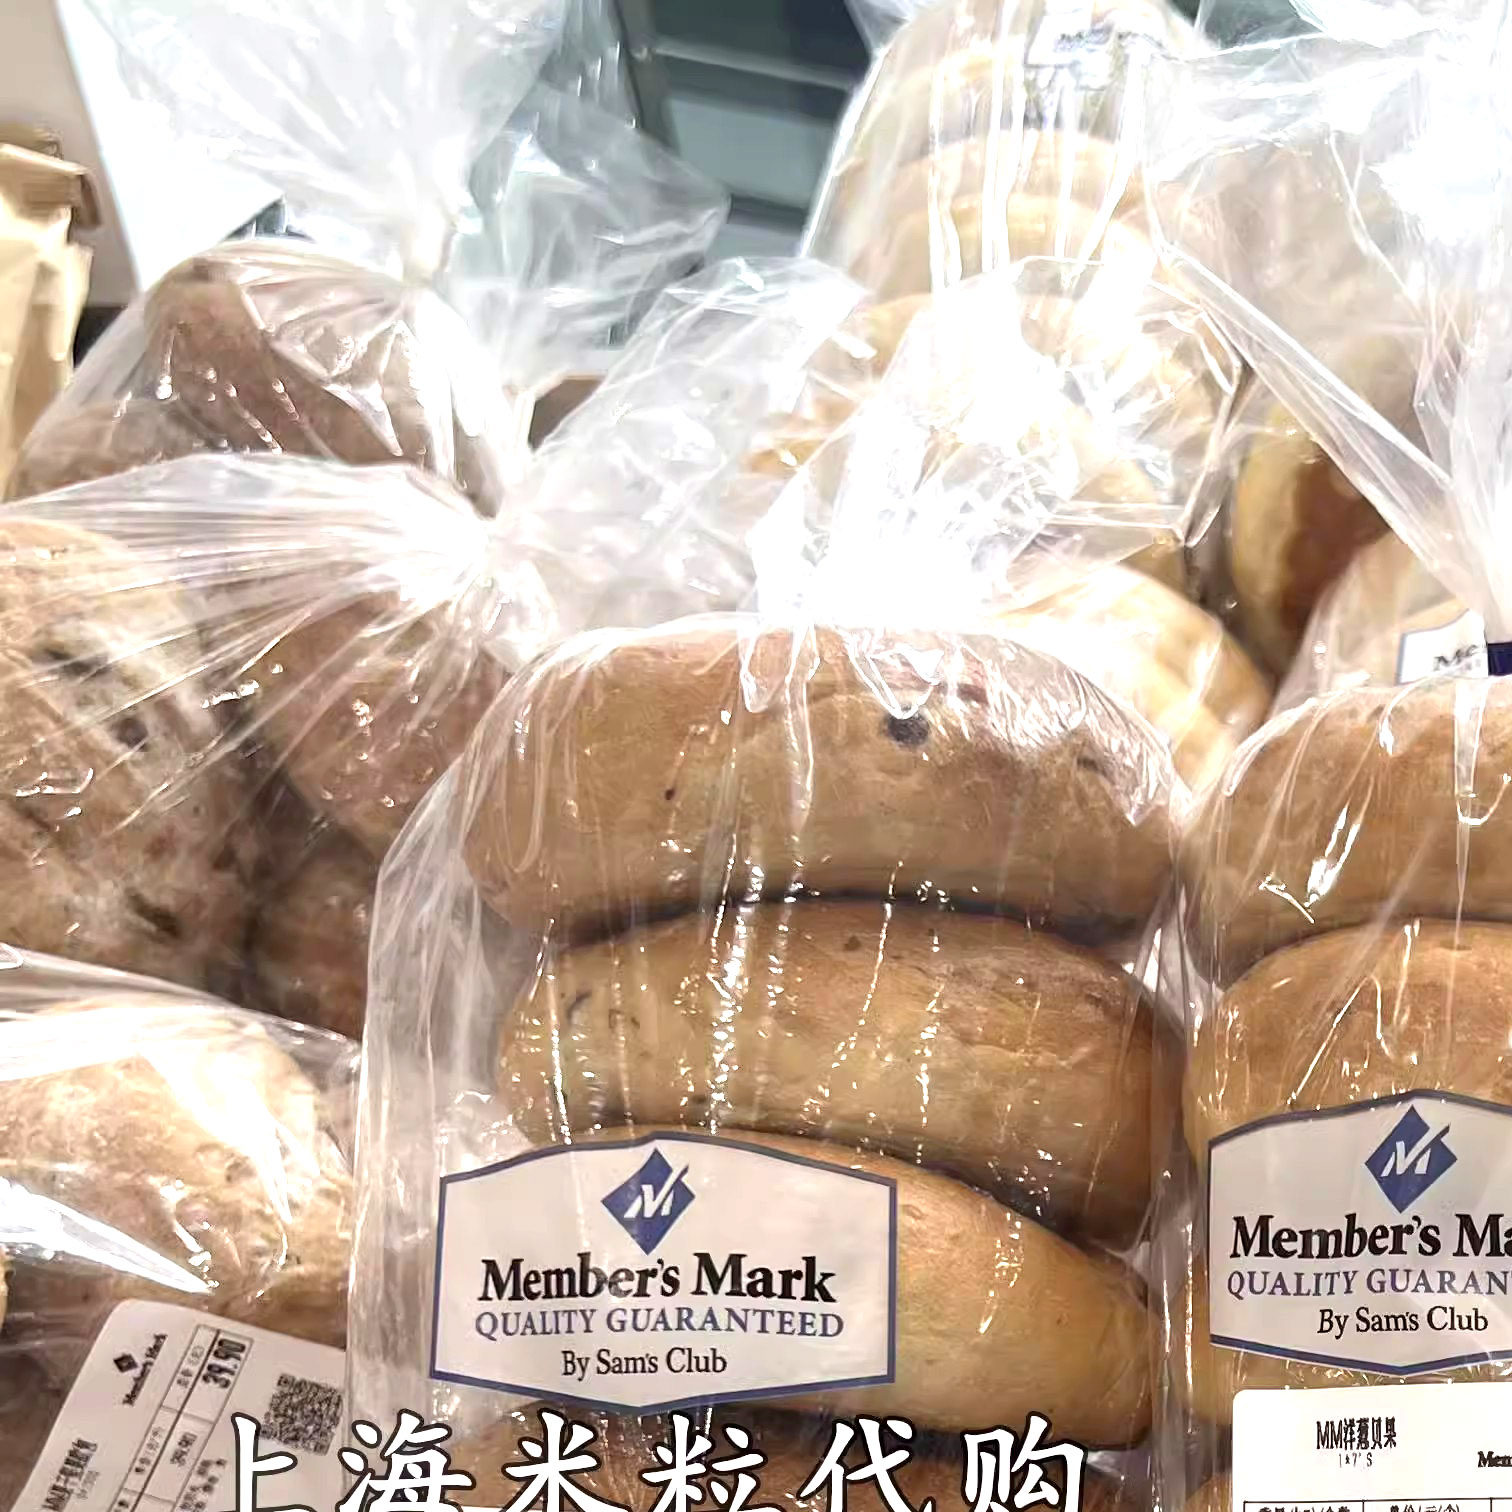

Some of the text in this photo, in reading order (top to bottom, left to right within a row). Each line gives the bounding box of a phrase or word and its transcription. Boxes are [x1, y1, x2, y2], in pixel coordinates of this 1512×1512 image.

[1230, 1213, 1441, 1259] Member's
[478, 1252, 837, 1303] Member's Mark
[1228, 1270, 1358, 1299] QUALITY
[475, 1307, 844, 1341] QUALITY GUARANTEED
[1318, 1306, 1489, 1339] By Sam's Club
[562, 1347, 727, 1381] By Sam's Club
[1316, 1416, 1397, 1451] MM洋葱贝果
